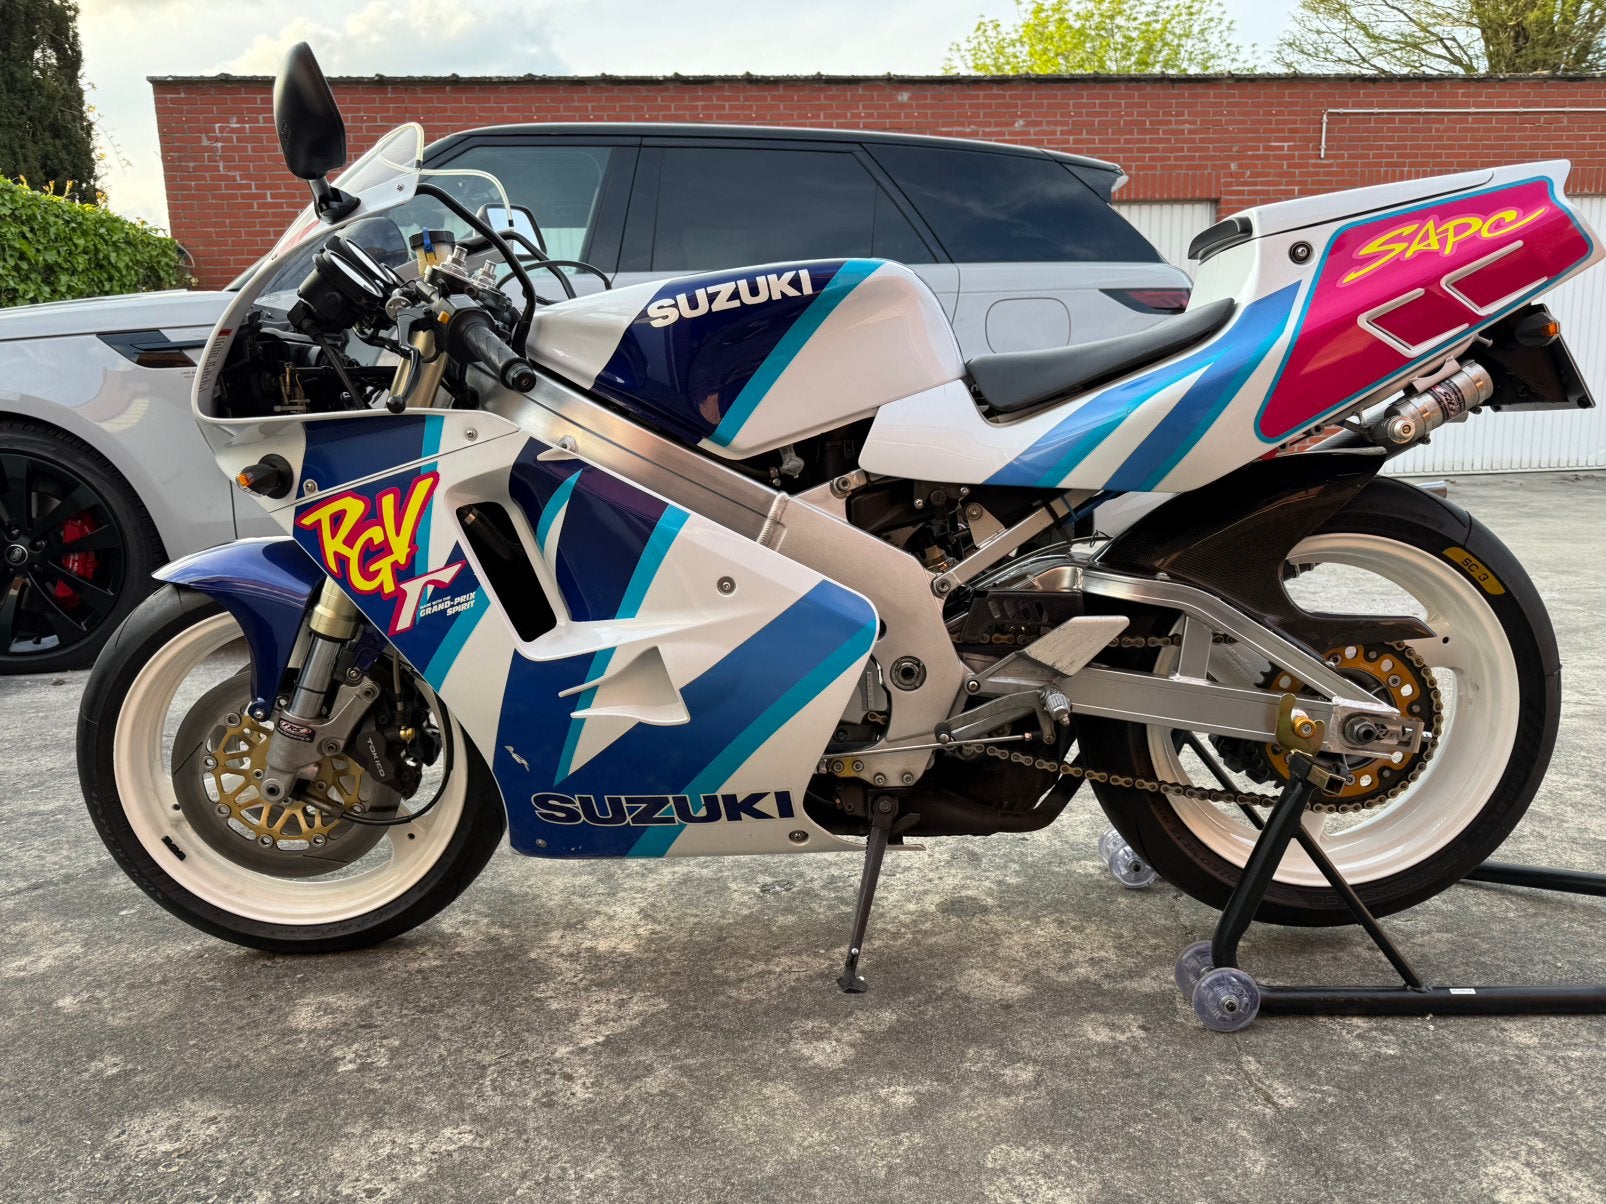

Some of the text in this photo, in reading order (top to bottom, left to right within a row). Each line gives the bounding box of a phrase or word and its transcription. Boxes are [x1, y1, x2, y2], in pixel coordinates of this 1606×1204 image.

[1341, 207, 1546, 284] SAPC
[647, 269, 813, 328] SUZUKI
[298, 474, 437, 597] RGV
[1461, 557, 1489, 582] SC 3
[420, 591, 476, 617] GRAND-PRIX
[446, 600, 475, 616] SPIRIT
[366, 737, 386, 778] TOKICO
[531, 790, 796, 826] SUZUKI
